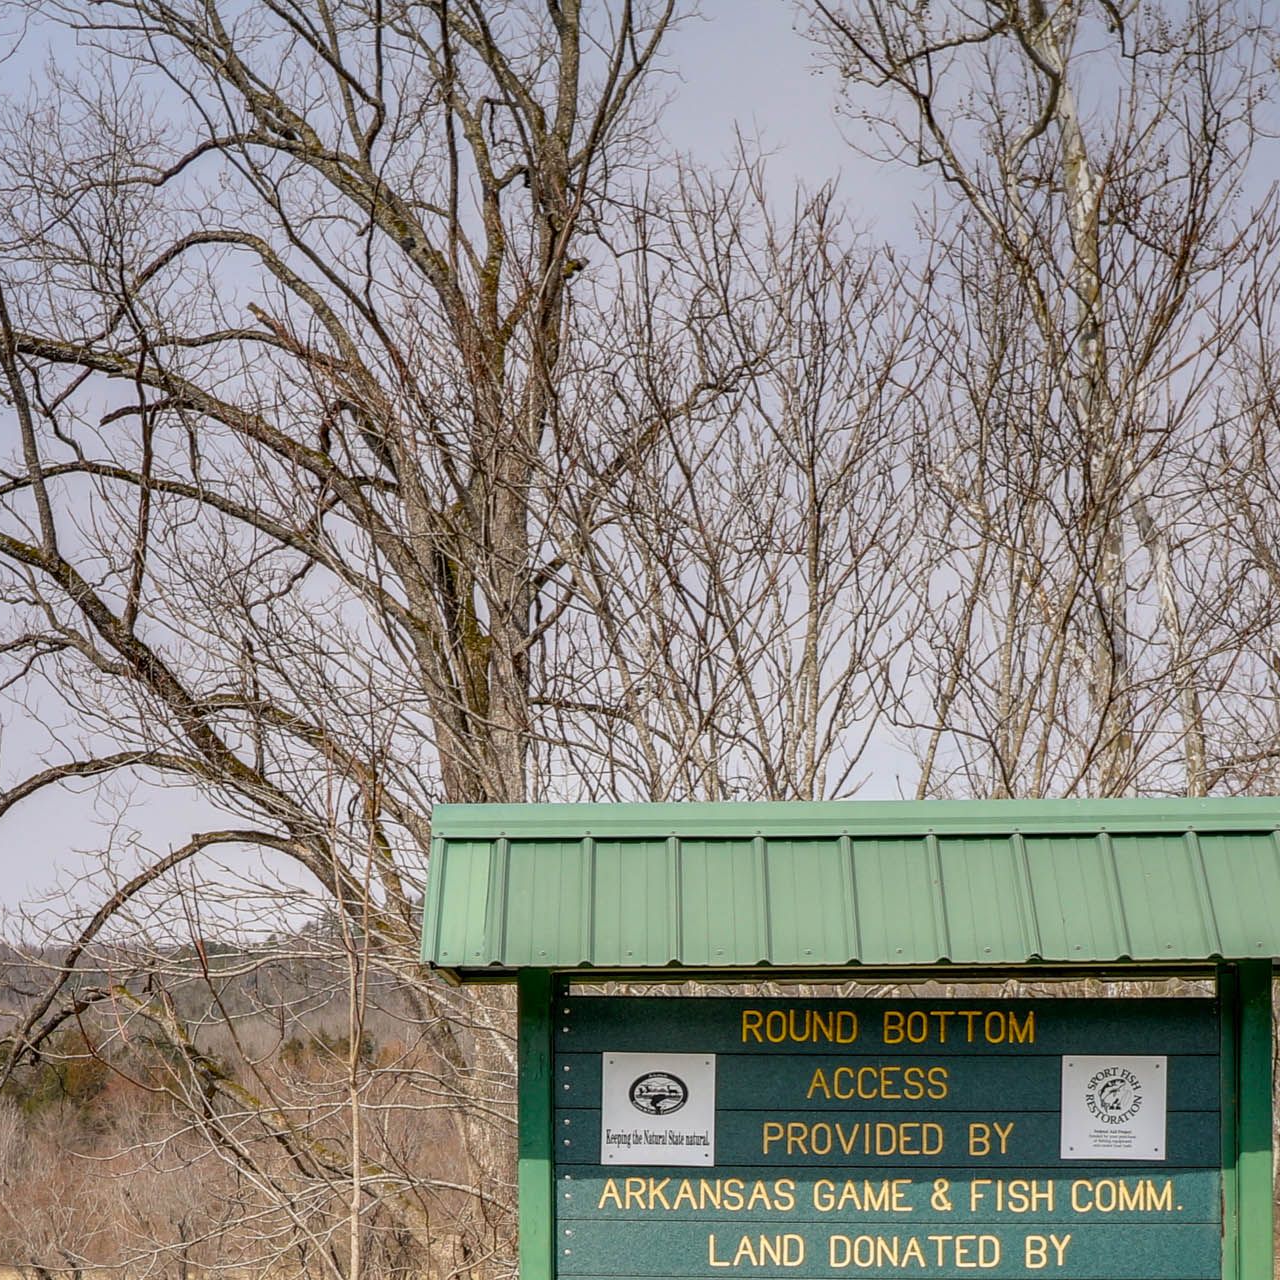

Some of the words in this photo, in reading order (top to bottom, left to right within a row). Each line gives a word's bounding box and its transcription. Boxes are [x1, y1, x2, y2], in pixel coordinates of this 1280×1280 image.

[741, 1010, 858, 1045] ROUND
[882, 1010, 1035, 1044] BOTTOM
[806, 1067, 948, 1100] ACCESS
[1085, 1094, 1143, 1125] RESTORATION
[606, 1129, 631, 1149] Keeping
[632, 1129, 642, 1145] the
[643, 1129, 667, 1145] Natural
[668, 1129, 684, 1146] State
[685, 1130, 710, 1146] natural.
[762, 1122, 946, 1157] PROVIDED
[968, 1123, 1015, 1156] BY
[598, 1178, 795, 1211] ARKANSAS
[813, 1179, 913, 1213] GAME
[930, 1180, 952, 1211] &
[970, 1179, 1054, 1212] FISH
[1071, 1180, 1183, 1213] COMM.
[708, 1234, 805, 1267] LAND
[829, 1235, 1001, 1269] DONATED
[1025, 1235, 1072, 1268] BY
